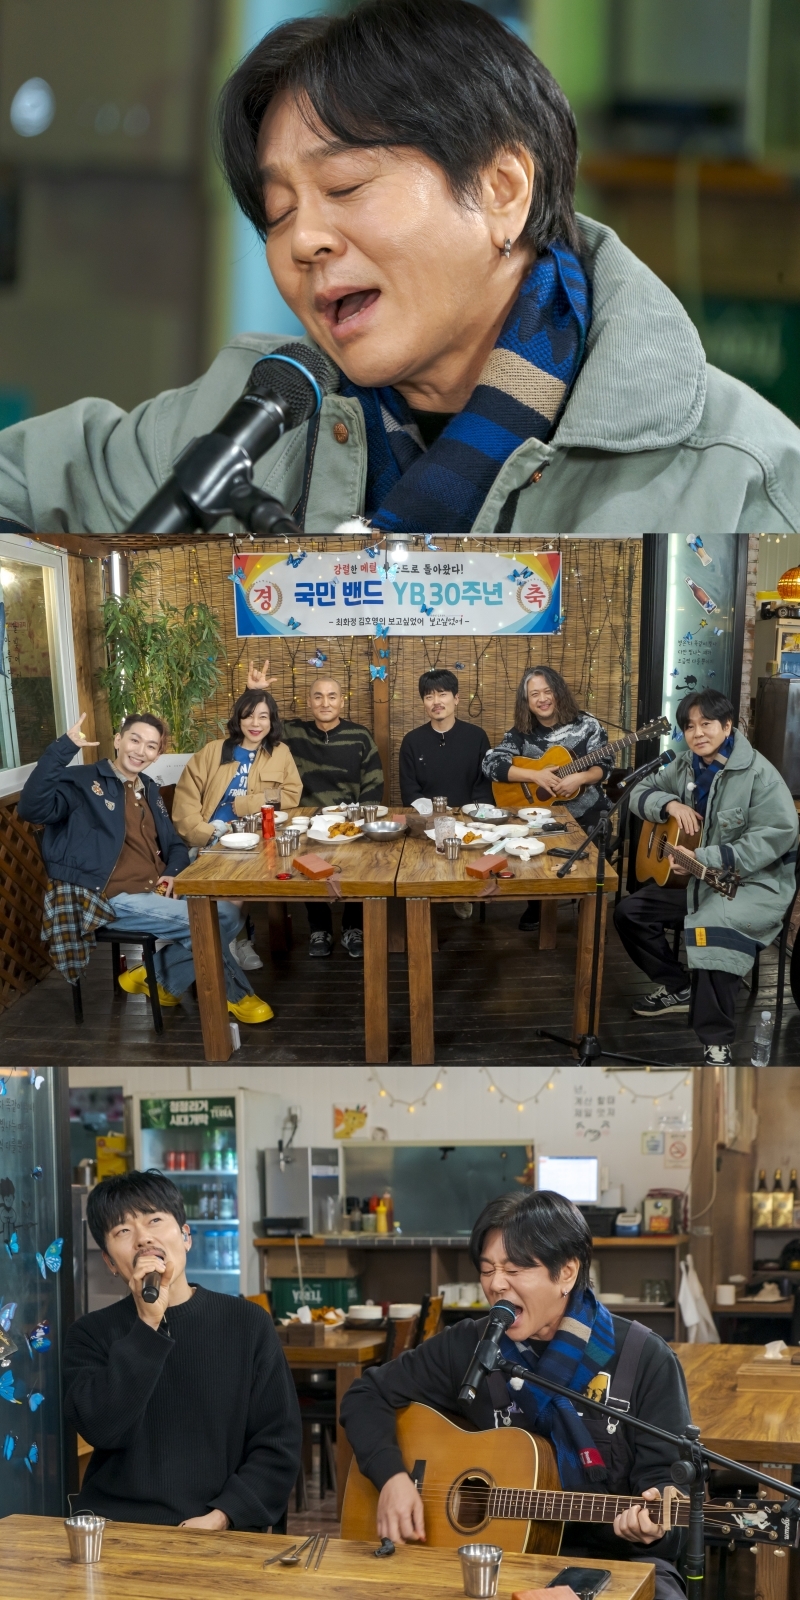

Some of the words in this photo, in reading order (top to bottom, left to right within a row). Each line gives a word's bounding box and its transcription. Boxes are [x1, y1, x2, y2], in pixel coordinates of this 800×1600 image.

[333, 563, 358, 576] 강렬한
[423, 563, 464, 576] 돌아왔다!
[253, 585, 273, 611] 경
[294, 582, 336, 607] 국민
[342, 580, 384, 607] 밴드
[524, 583, 547, 608] 축
[336, 617, 357, 627] 최화정
[358, 616, 386, 626] 김호영의
[388, 616, 425, 627] 보고싶었어
